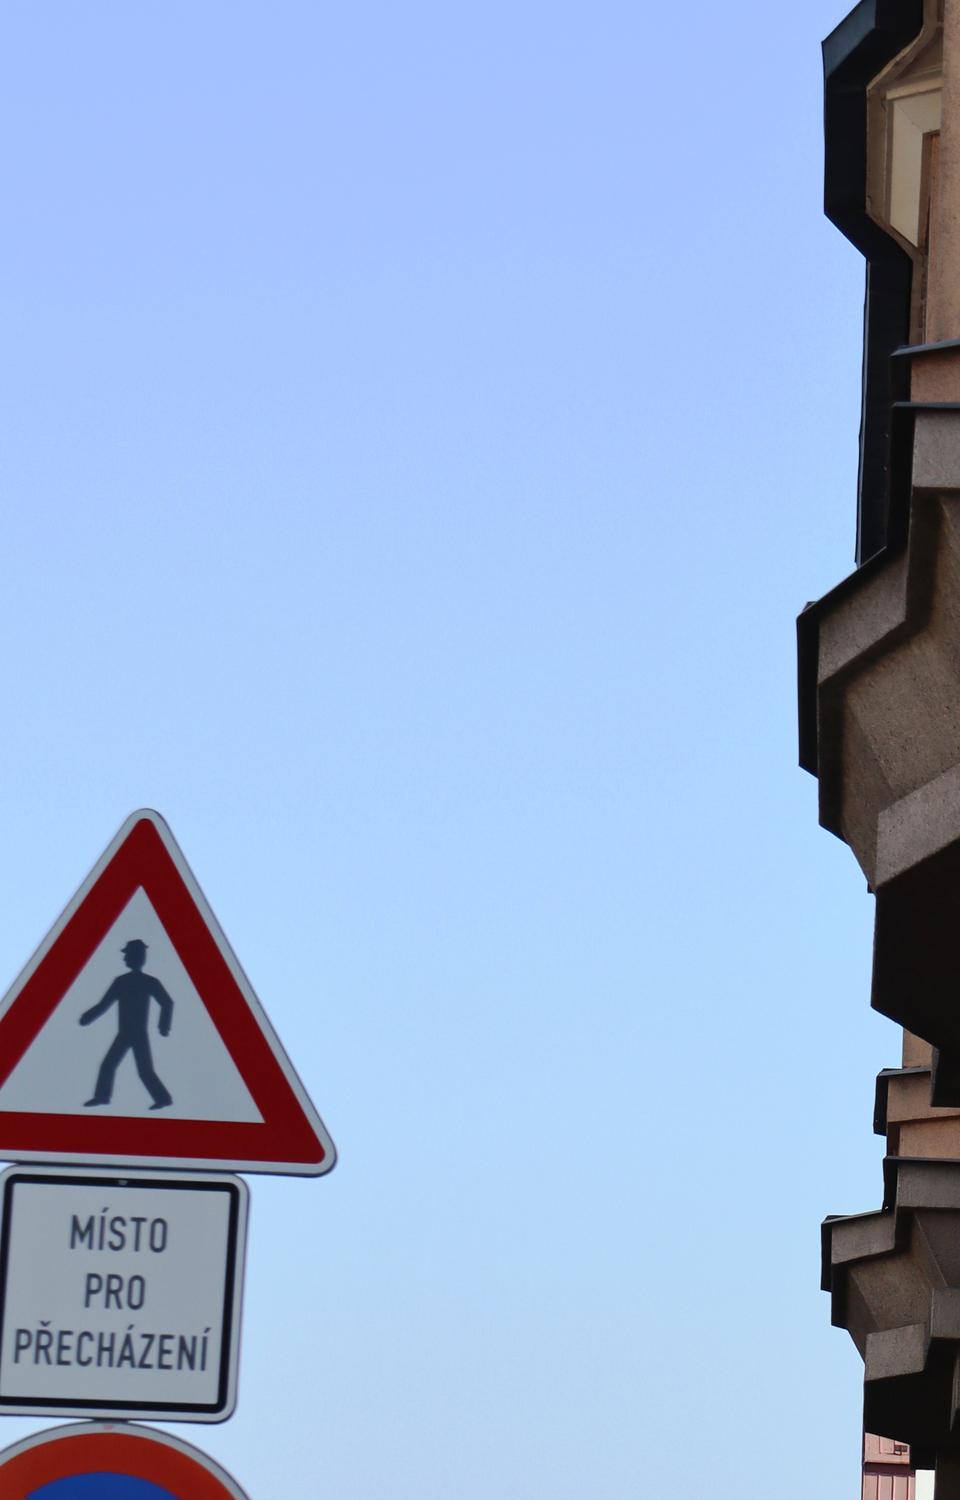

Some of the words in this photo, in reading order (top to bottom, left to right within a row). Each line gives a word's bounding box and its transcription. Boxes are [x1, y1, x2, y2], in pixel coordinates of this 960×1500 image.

[70, 1207, 168, 1253] MÍSTO
[84, 1273, 146, 1310] PRO
[13, 1320, 212, 1371] PŘECHÁZENÍ
